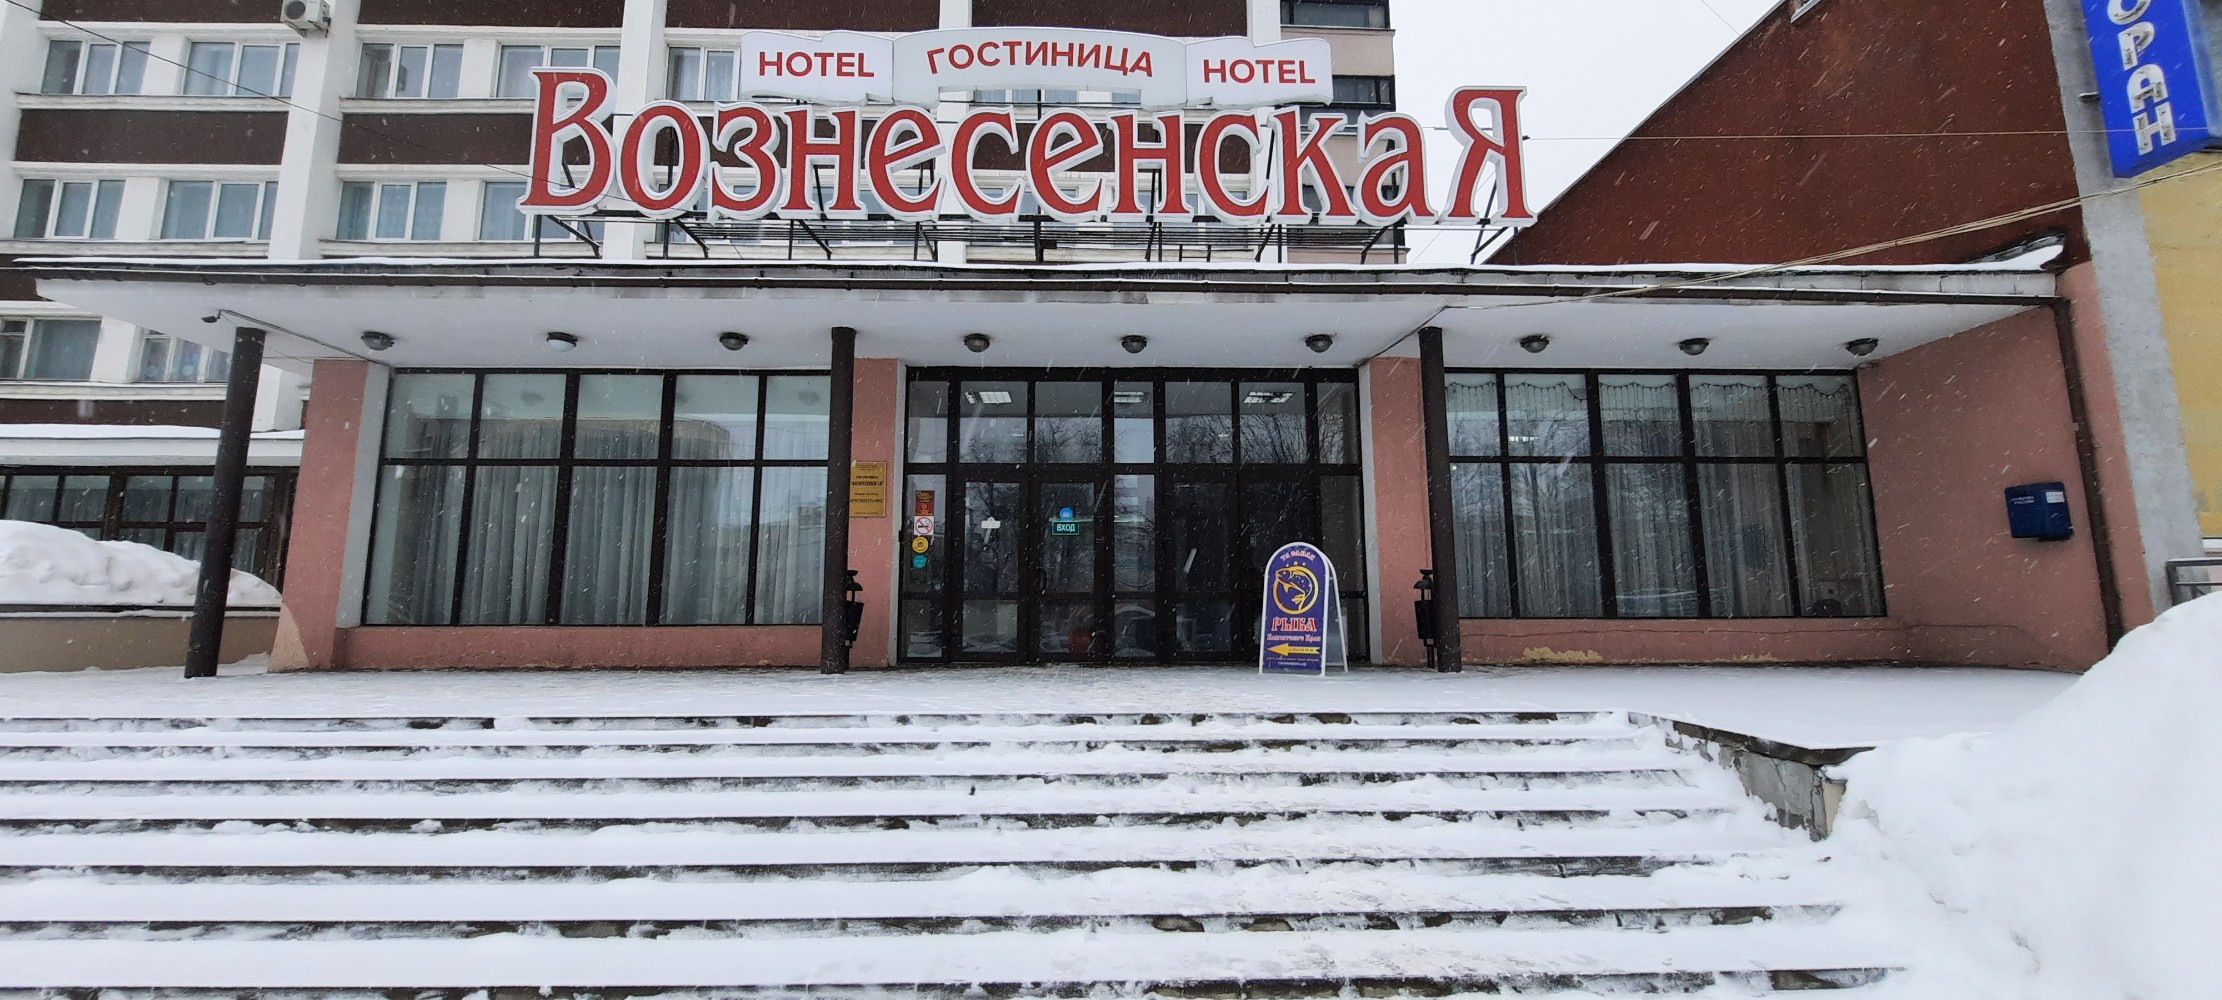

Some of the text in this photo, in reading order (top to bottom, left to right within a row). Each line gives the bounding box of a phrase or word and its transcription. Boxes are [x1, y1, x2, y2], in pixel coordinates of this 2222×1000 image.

[759, 51, 875, 77] HOTEL
[926, 41, 1153, 77] ГОСТИНИЦА
[1203, 59, 1316, 84] HOTEL
[1056, 523, 1076, 533] ВХОД
[1271, 617, 1317, 632] РЫБА
